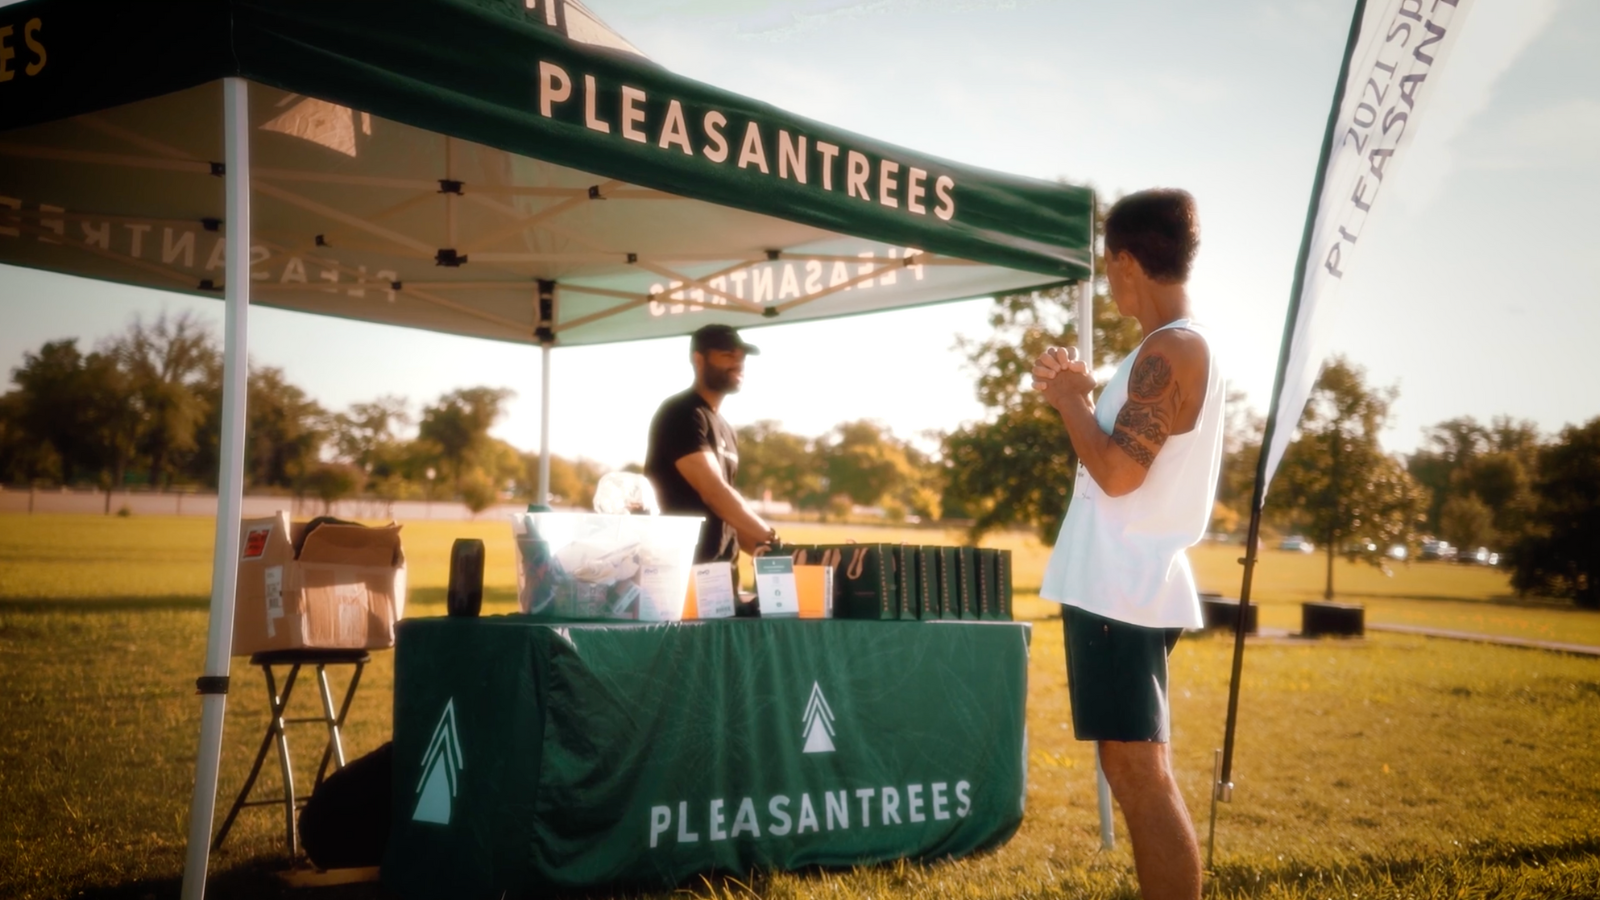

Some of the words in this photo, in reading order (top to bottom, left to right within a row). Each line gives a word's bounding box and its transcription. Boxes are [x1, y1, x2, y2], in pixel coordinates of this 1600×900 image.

[539, 61, 956, 221] PLEASANTREES
[1342, 60, 1399, 156] 2021
[649, 780, 972, 848] PLEASANTREES
